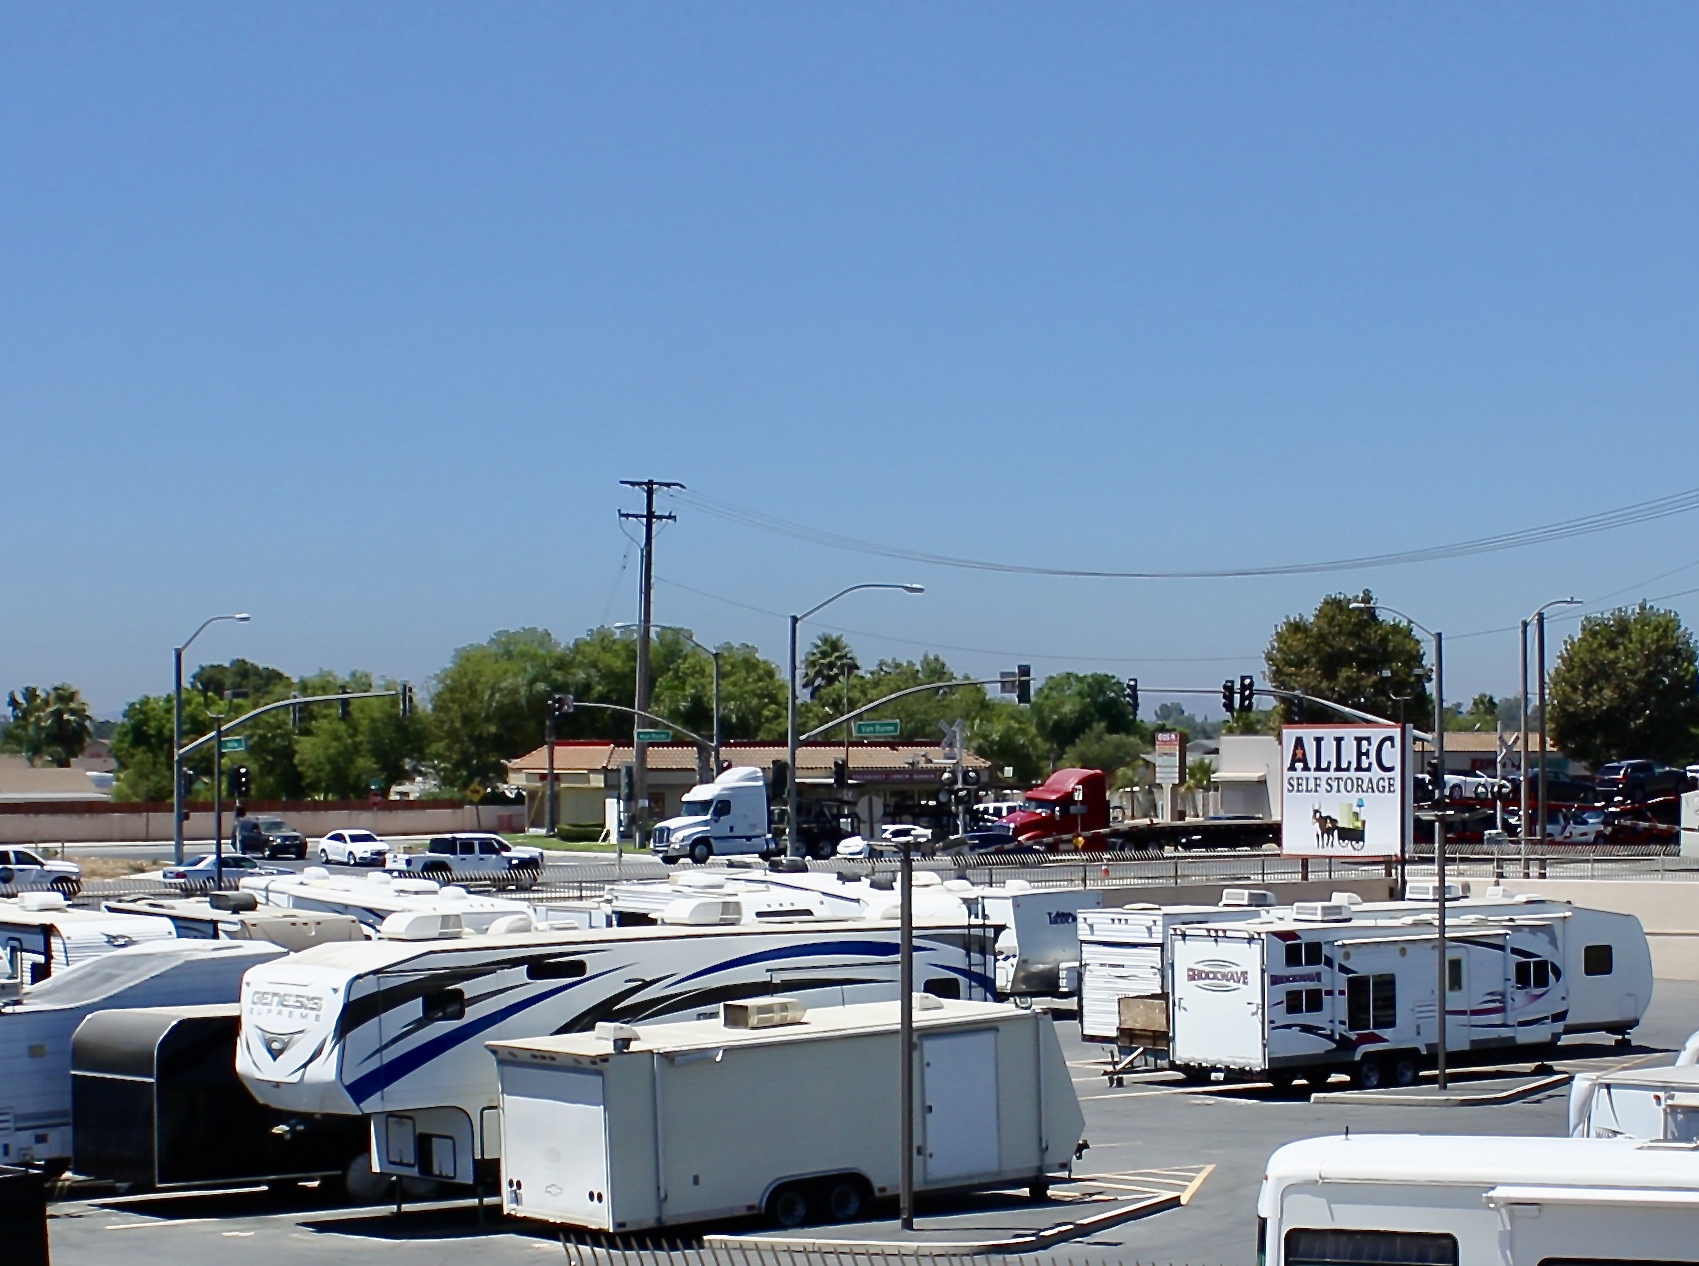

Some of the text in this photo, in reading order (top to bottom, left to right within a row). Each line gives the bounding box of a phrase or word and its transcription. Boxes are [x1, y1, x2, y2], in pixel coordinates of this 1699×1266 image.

[861, 725, 895, 733] Van Buren
[1287, 735, 1396, 774] ALLEC
[1287, 776, 1396, 793] SELF STORAGE
[1187, 967, 1248, 986] SHOCKWAVE
[252, 991, 323, 1011] GENESIS
[250, 1007, 321, 1022] SUPREME
